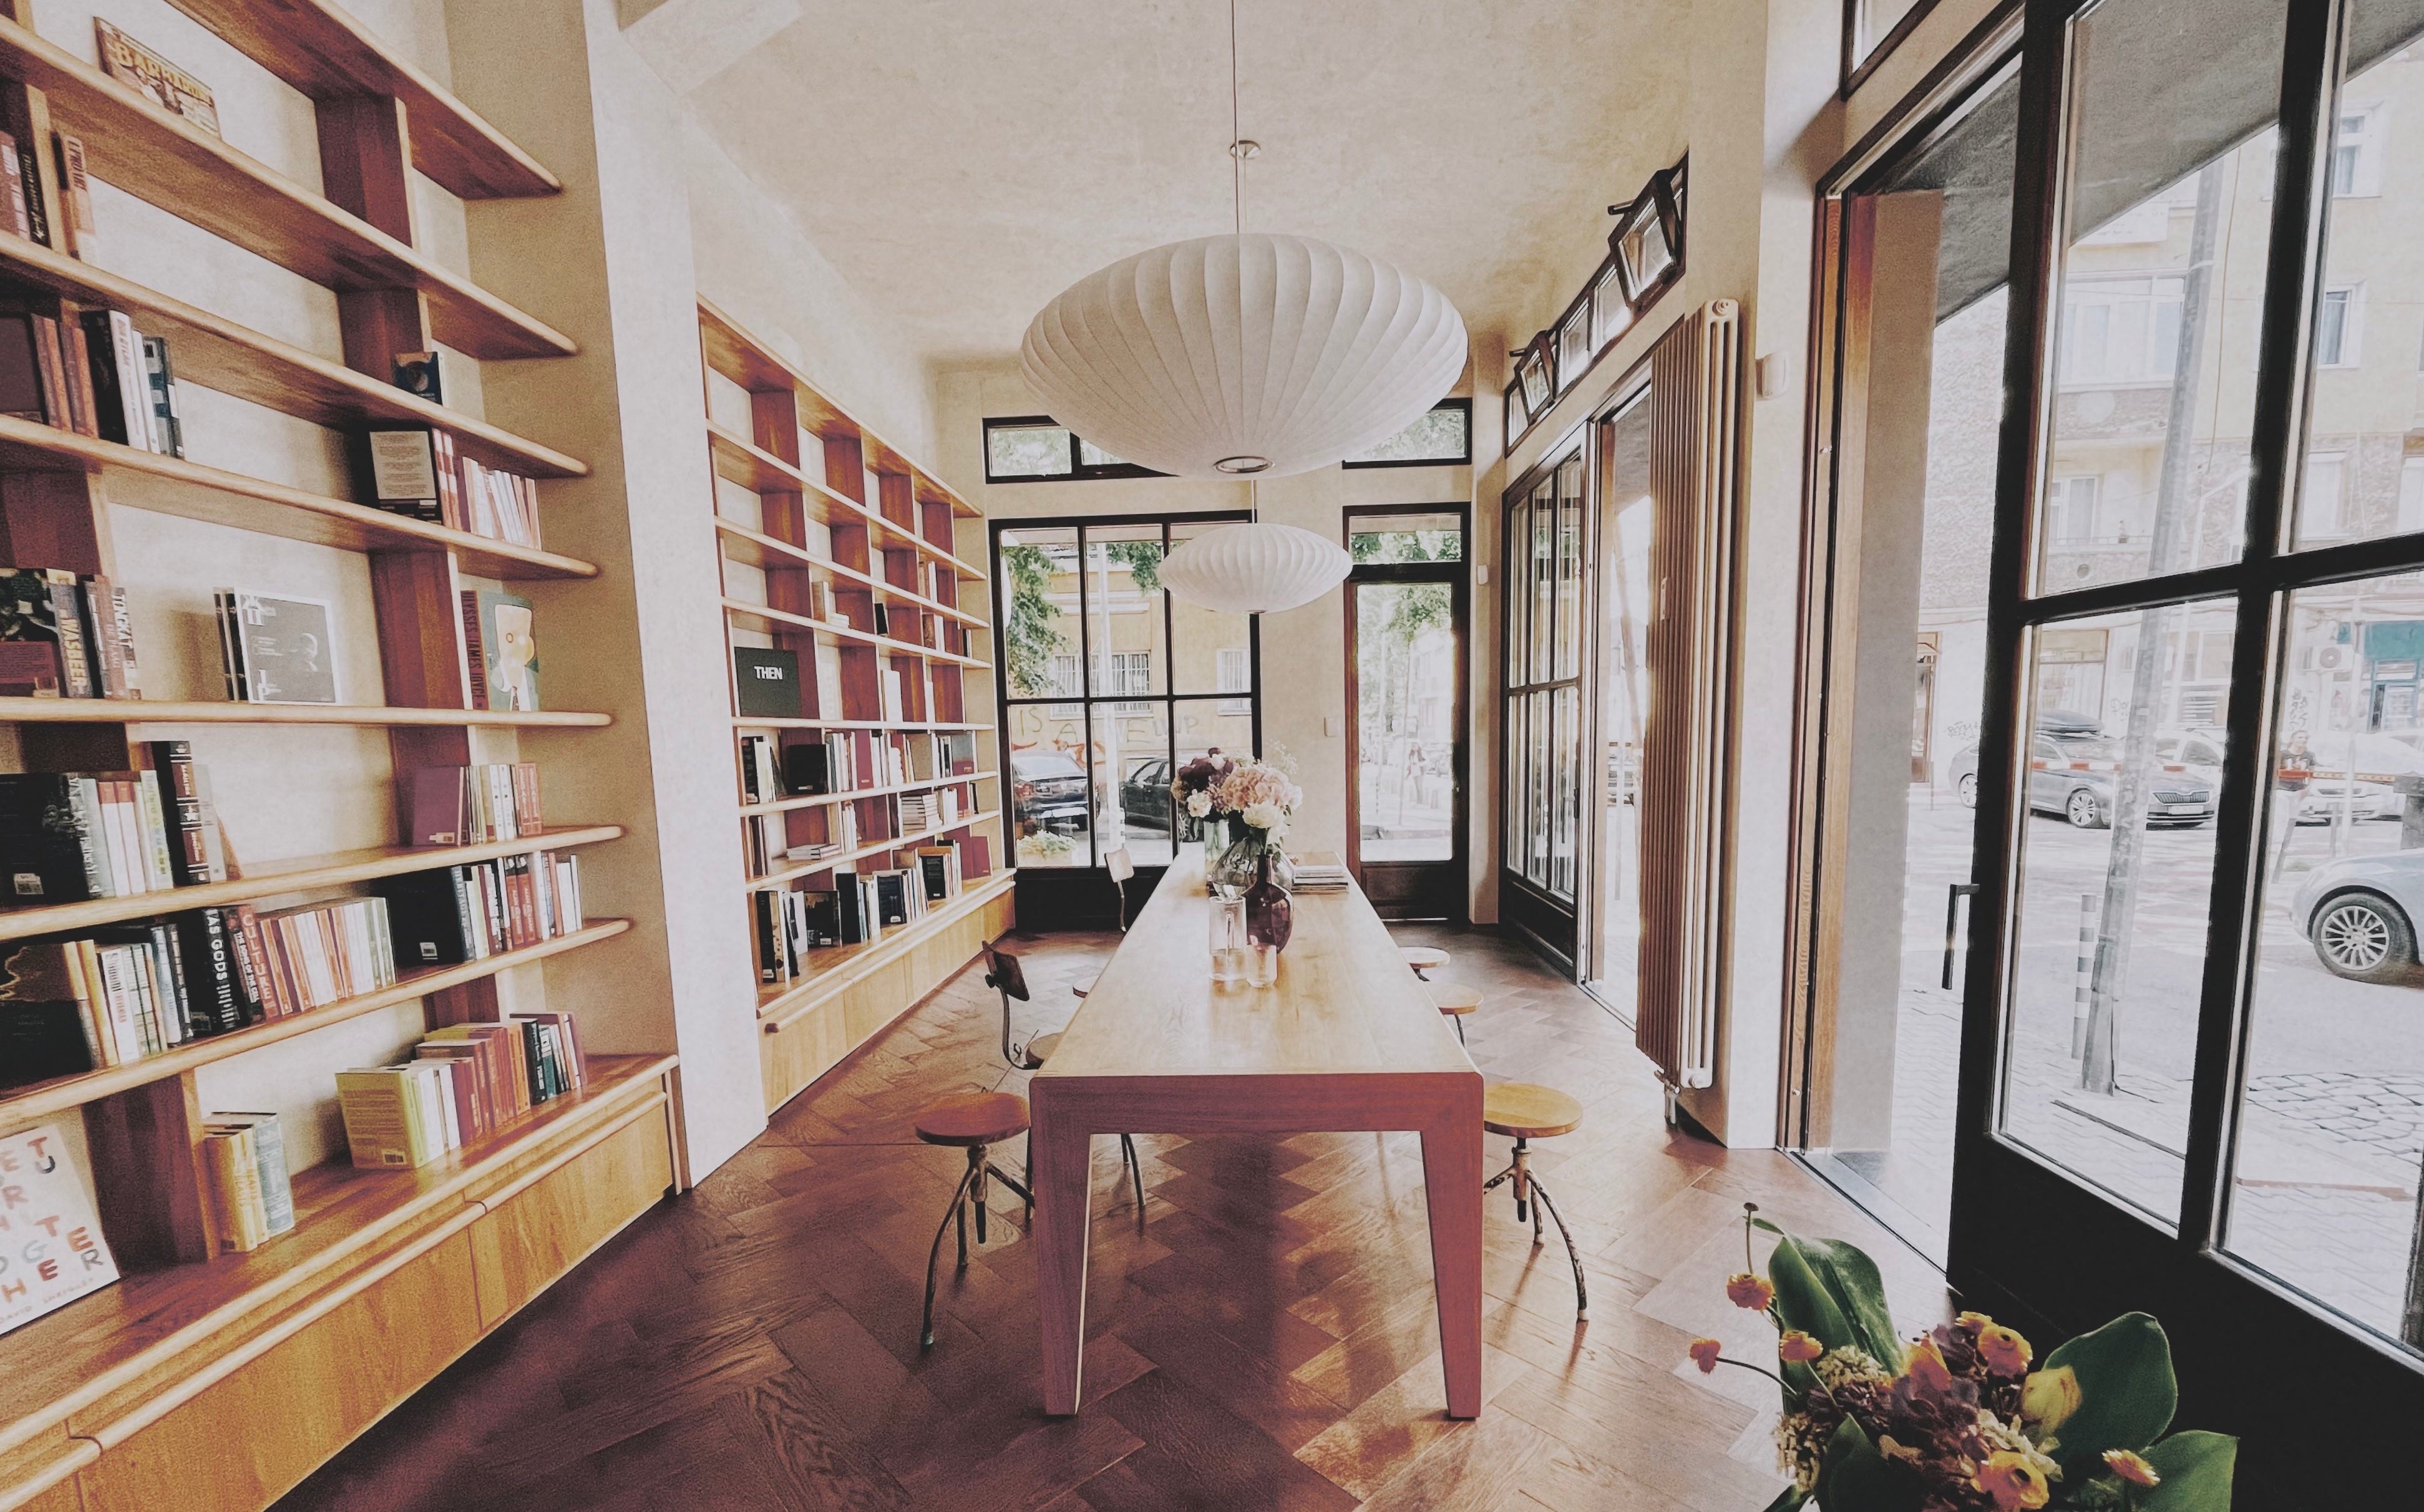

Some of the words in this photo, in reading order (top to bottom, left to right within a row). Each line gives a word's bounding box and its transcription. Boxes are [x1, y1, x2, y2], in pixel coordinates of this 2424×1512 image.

[462, 592, 477, 632] ULYSSES
[467, 639, 482, 669] JAMES
[470, 672, 485, 698] JOYCE
[754, 666, 784, 680] THEN
[207, 916, 221, 934] AS
[212, 939, 228, 981] GODS
[243, 914, 271, 999] CULTURE
